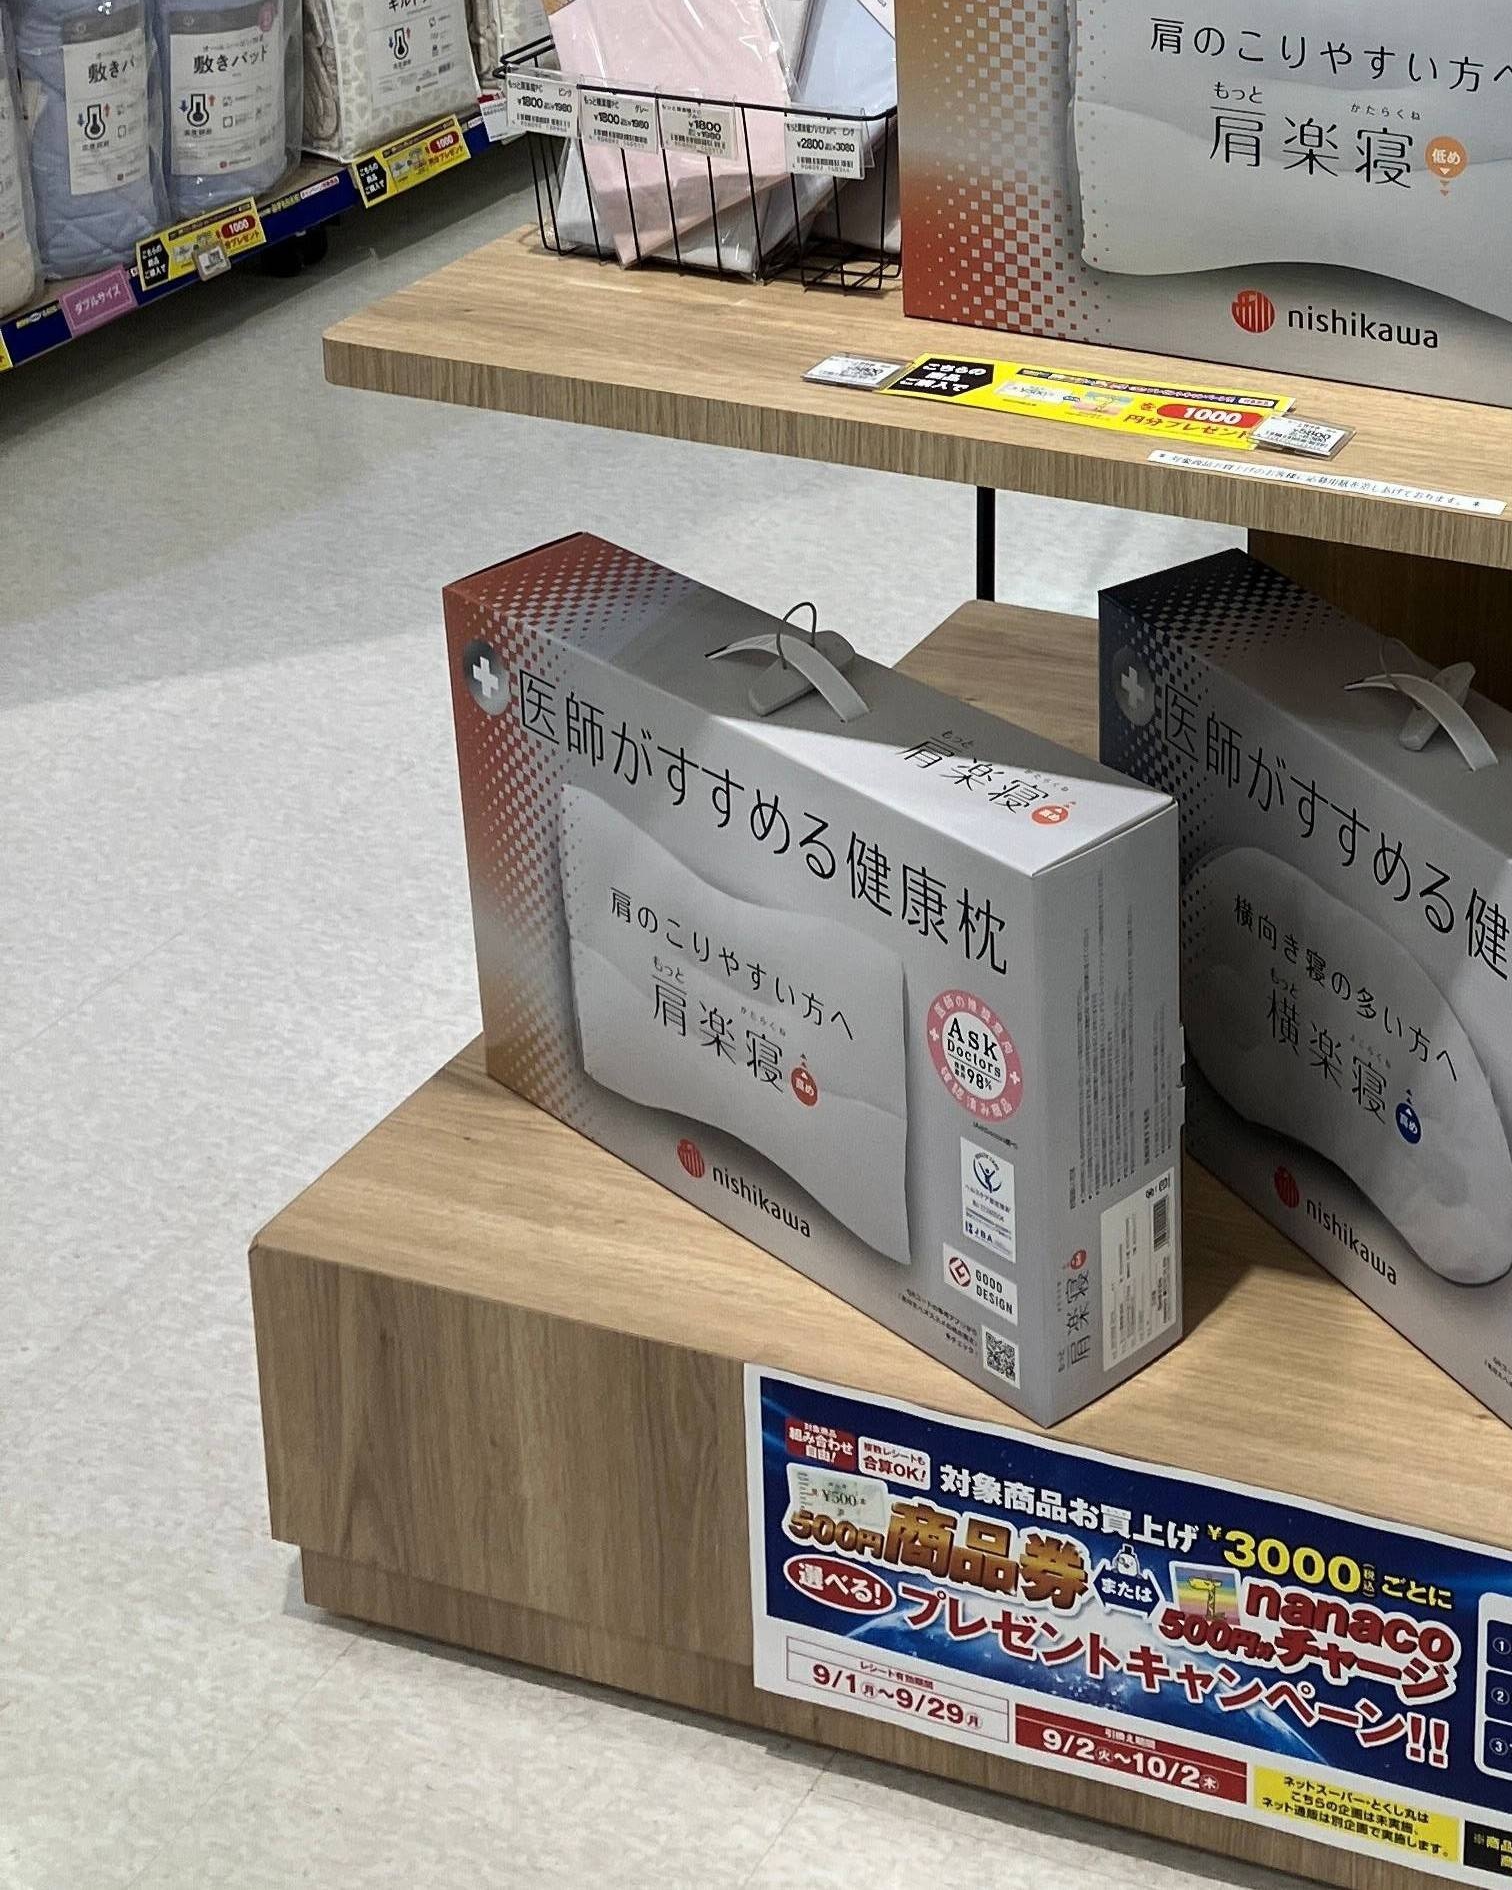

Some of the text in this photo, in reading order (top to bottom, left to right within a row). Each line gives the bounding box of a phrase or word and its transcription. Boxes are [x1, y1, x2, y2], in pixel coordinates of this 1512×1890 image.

[193, 45, 268, 74] 敷きパッド
[1214, 80, 1264, 104] もっと
[1350, 102, 1422, 121] かたらくね
[688, 121, 722, 134] ¥1800
[1209, 104, 1415, 189] 肩楽寝
[1431, 148, 1461, 165] 低め
[229, 219, 249, 233] 1000
[1288, 305, 1440, 350] nishikawa
[1182, 406, 1243, 424] 1000
[896, 737, 1049, 814] 肩楽寝
[517, 668, 1009, 977] 医師がすすめる健康枕
[610, 887, 853, 1041] 肩のこりやすい方へ
[1233, 894, 1458, 1082] 横向き寝の多い方へ
[652, 975, 784, 1093] 肩楽寝
[947, 1017, 998, 1062] Ask
[1266, 988, 1386, 1125] 横楽寝
[947, 1038, 1002, 1078] Doctors
[966, 1068, 993, 1091] 98%
[712, 1165, 811, 1238] nishikawa
[1306, 1198, 1397, 1286] nishikawa
[975, 1269, 1004, 1294] GOOD
[976, 1284, 1014, 1316] DESIGN
[789, 1427, 854, 1456] 組み合わせ
[863, 1455, 927, 1482] 合算OK!
[789, 1500, 1091, 1612] 500円 商品券
[939, 1464, 1455, 1610] 対象商品お買上げ ¥3000 ごとに
[1100, 1577, 1154, 1605] または
[1245, 1582, 1456, 1663] nanaco
[799, 1562, 1452, 1770] 選べる! プレゼントキャンペーン!!
